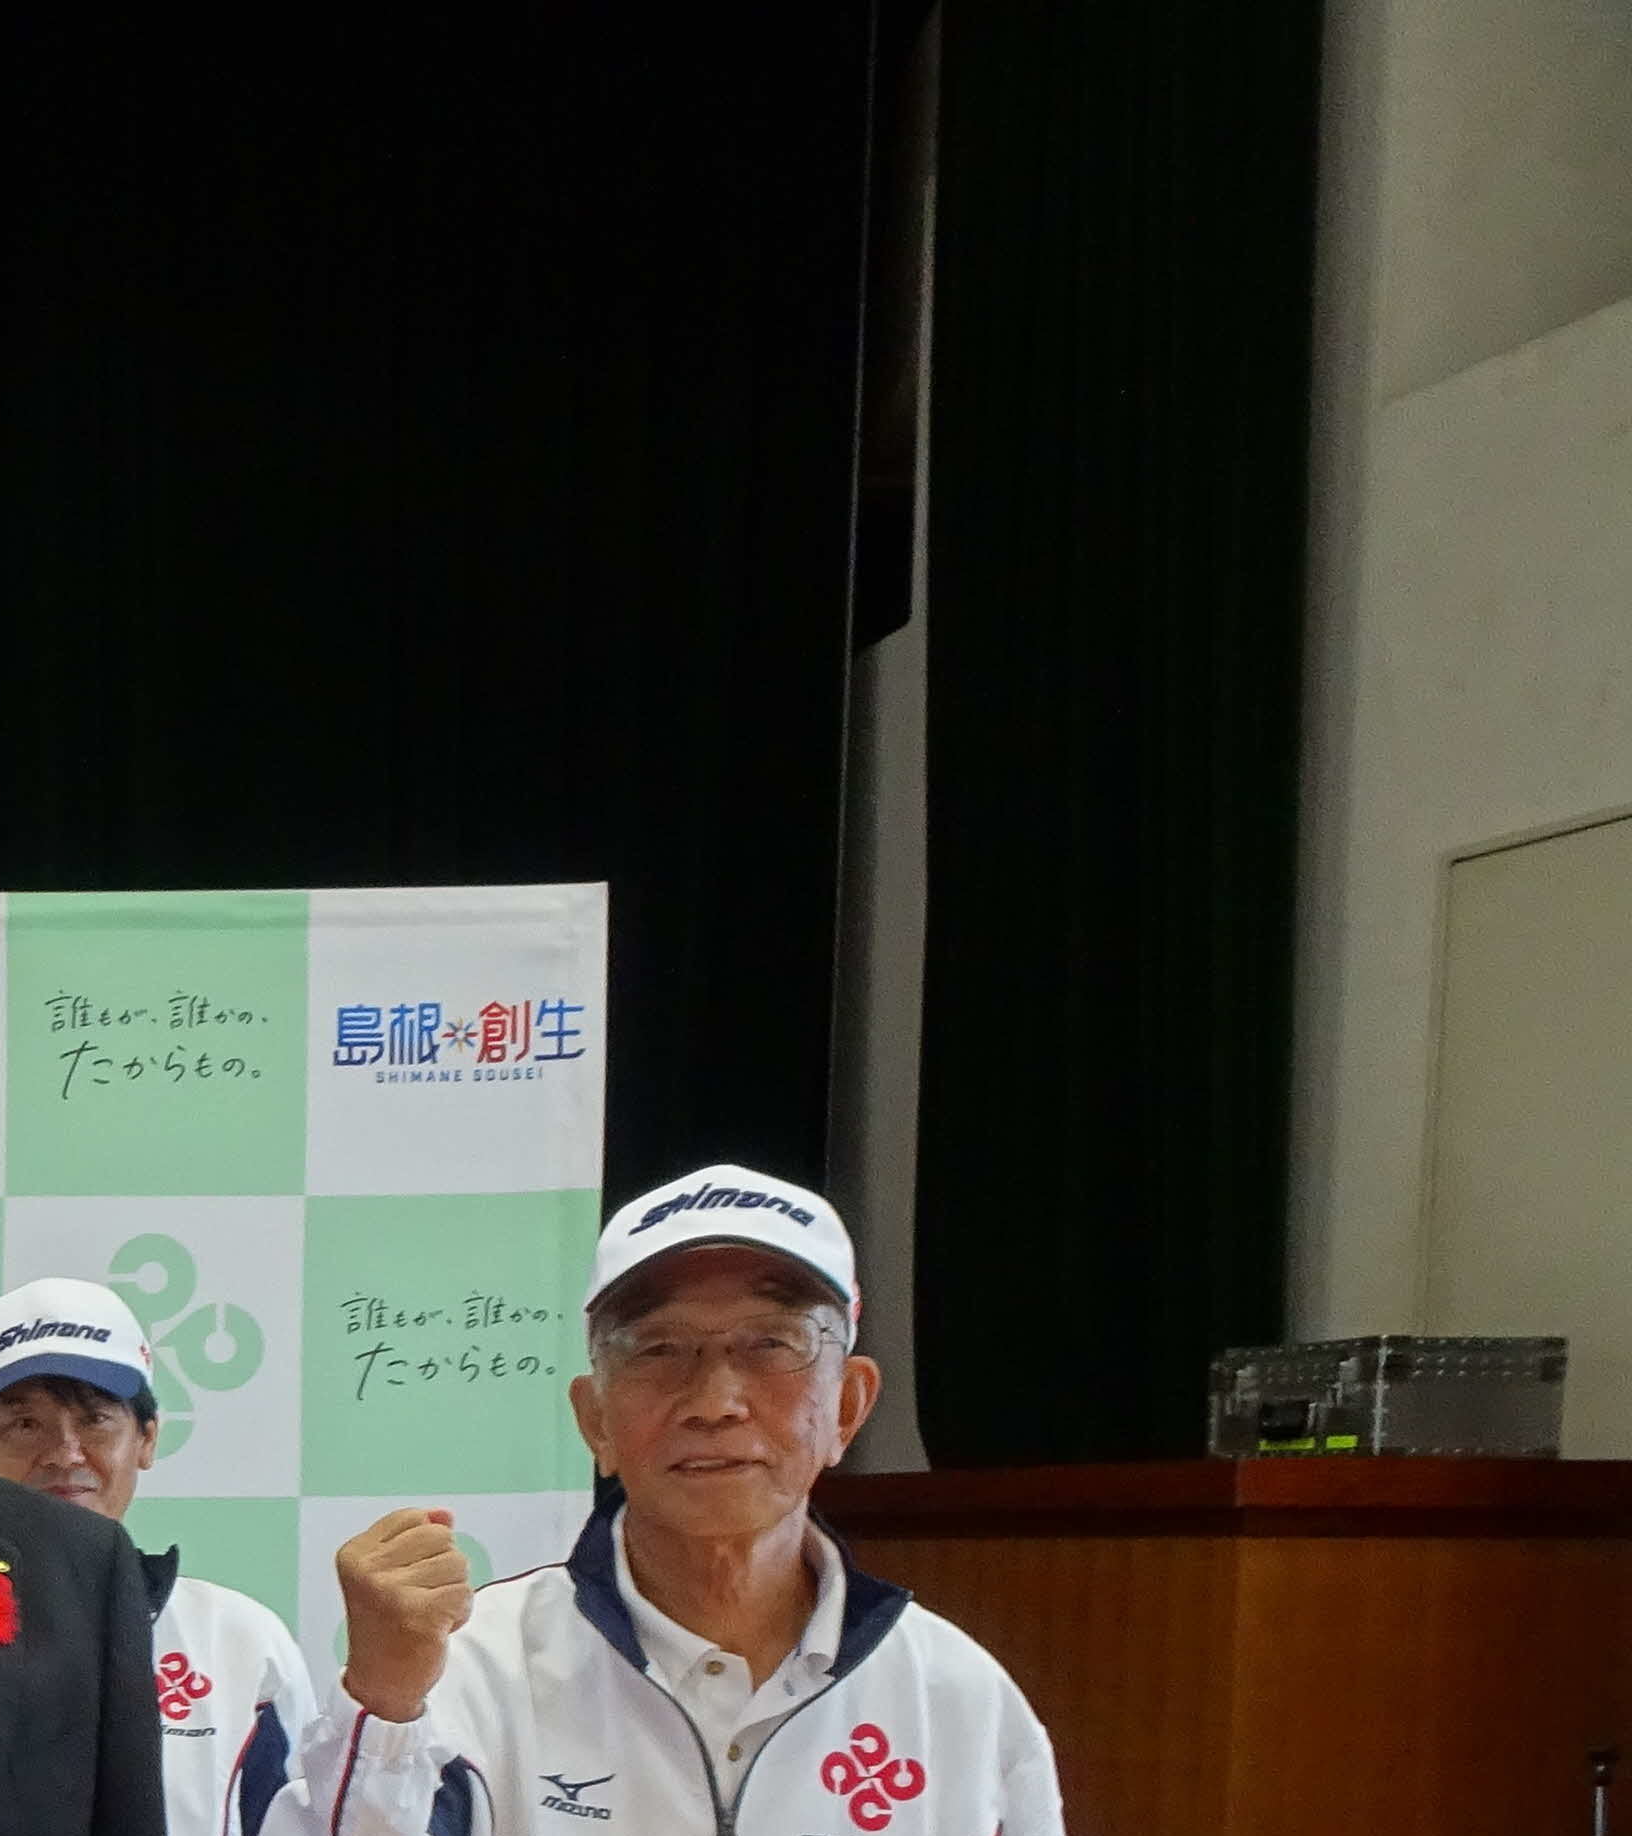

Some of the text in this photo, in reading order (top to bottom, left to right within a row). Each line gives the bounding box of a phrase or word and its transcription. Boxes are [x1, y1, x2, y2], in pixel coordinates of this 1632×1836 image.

[59, 1041, 261, 1100] たからもの。
[376, 1067, 544, 1084] SHIMANE SOUSEI
[628, 1183, 815, 1237] Shimane
[354, 1342, 556, 1401] たからもの。
